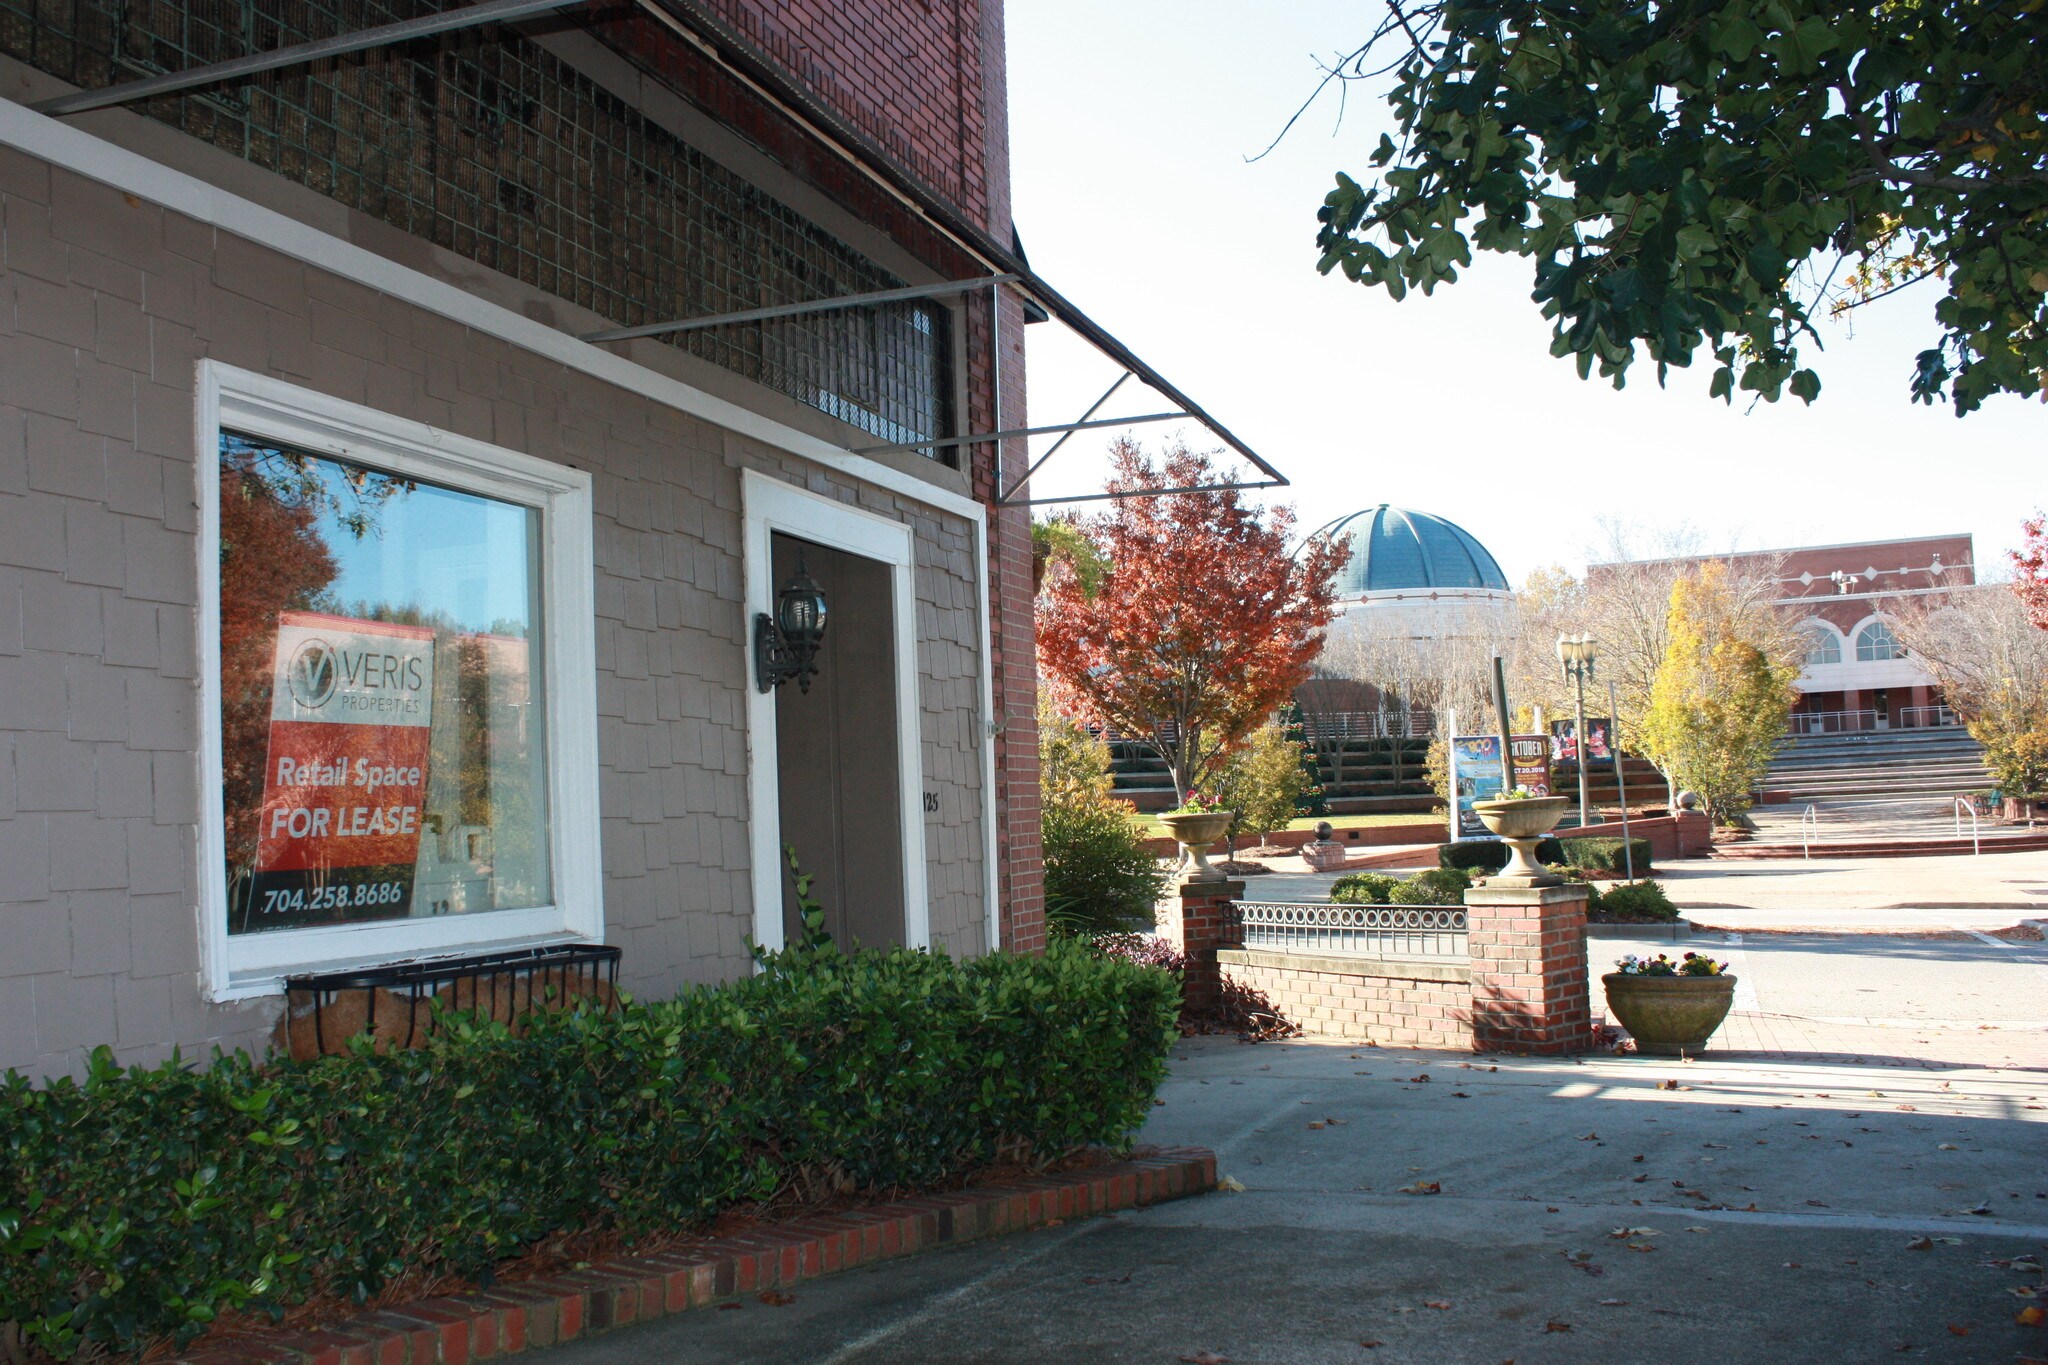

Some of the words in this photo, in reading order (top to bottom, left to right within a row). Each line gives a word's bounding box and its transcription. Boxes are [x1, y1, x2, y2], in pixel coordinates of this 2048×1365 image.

[343, 651, 422, 691] VERIS
[341, 695, 419, 714] PROPERTIES
[277, 756, 348, 786] Retail
[353, 757, 420, 794] Space
[923, 791, 938, 812] 125
[270, 807, 330, 838] FOR
[337, 806, 416, 836] LEASE
[263, 881, 401, 914] 704.258.8686
